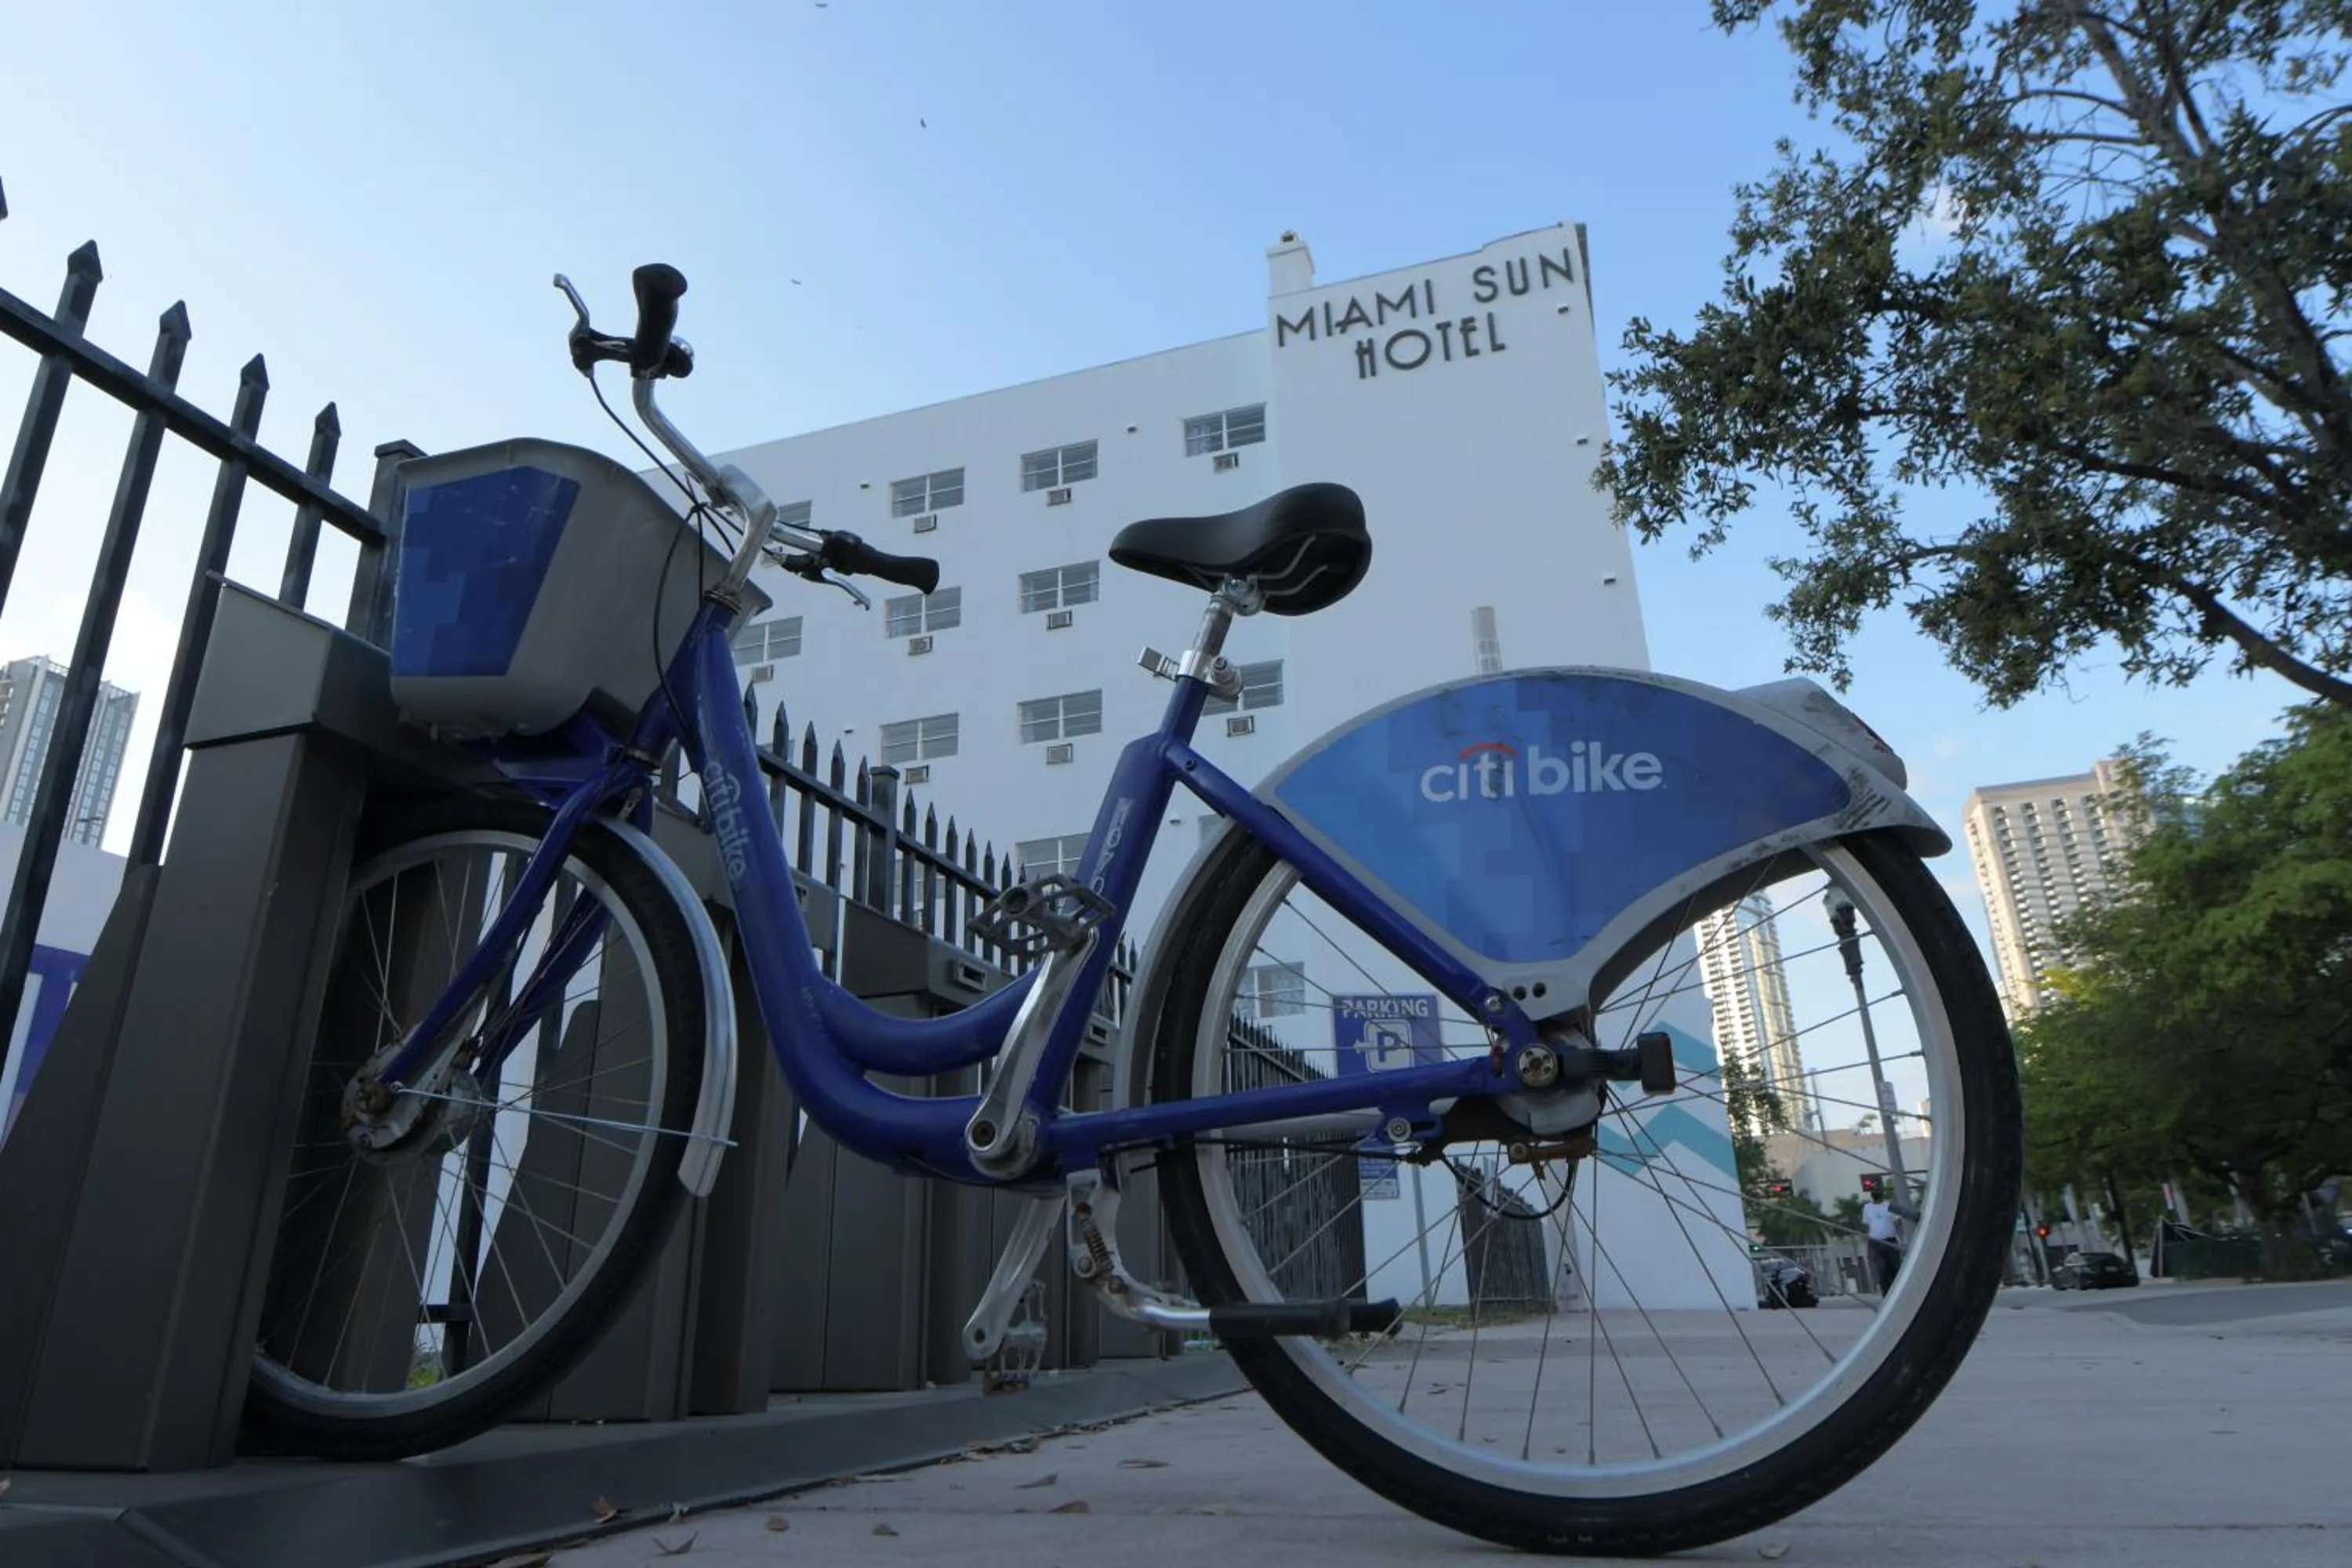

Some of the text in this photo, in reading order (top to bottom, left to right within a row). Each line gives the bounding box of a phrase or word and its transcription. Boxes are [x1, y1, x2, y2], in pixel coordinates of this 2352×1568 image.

[1276, 248, 1575, 347] MIAMI SUN
[1354, 311, 1506, 379] HOTEL
[1341, 998, 1429, 1018] PARKING
[1376, 1030, 1401, 1062] P
